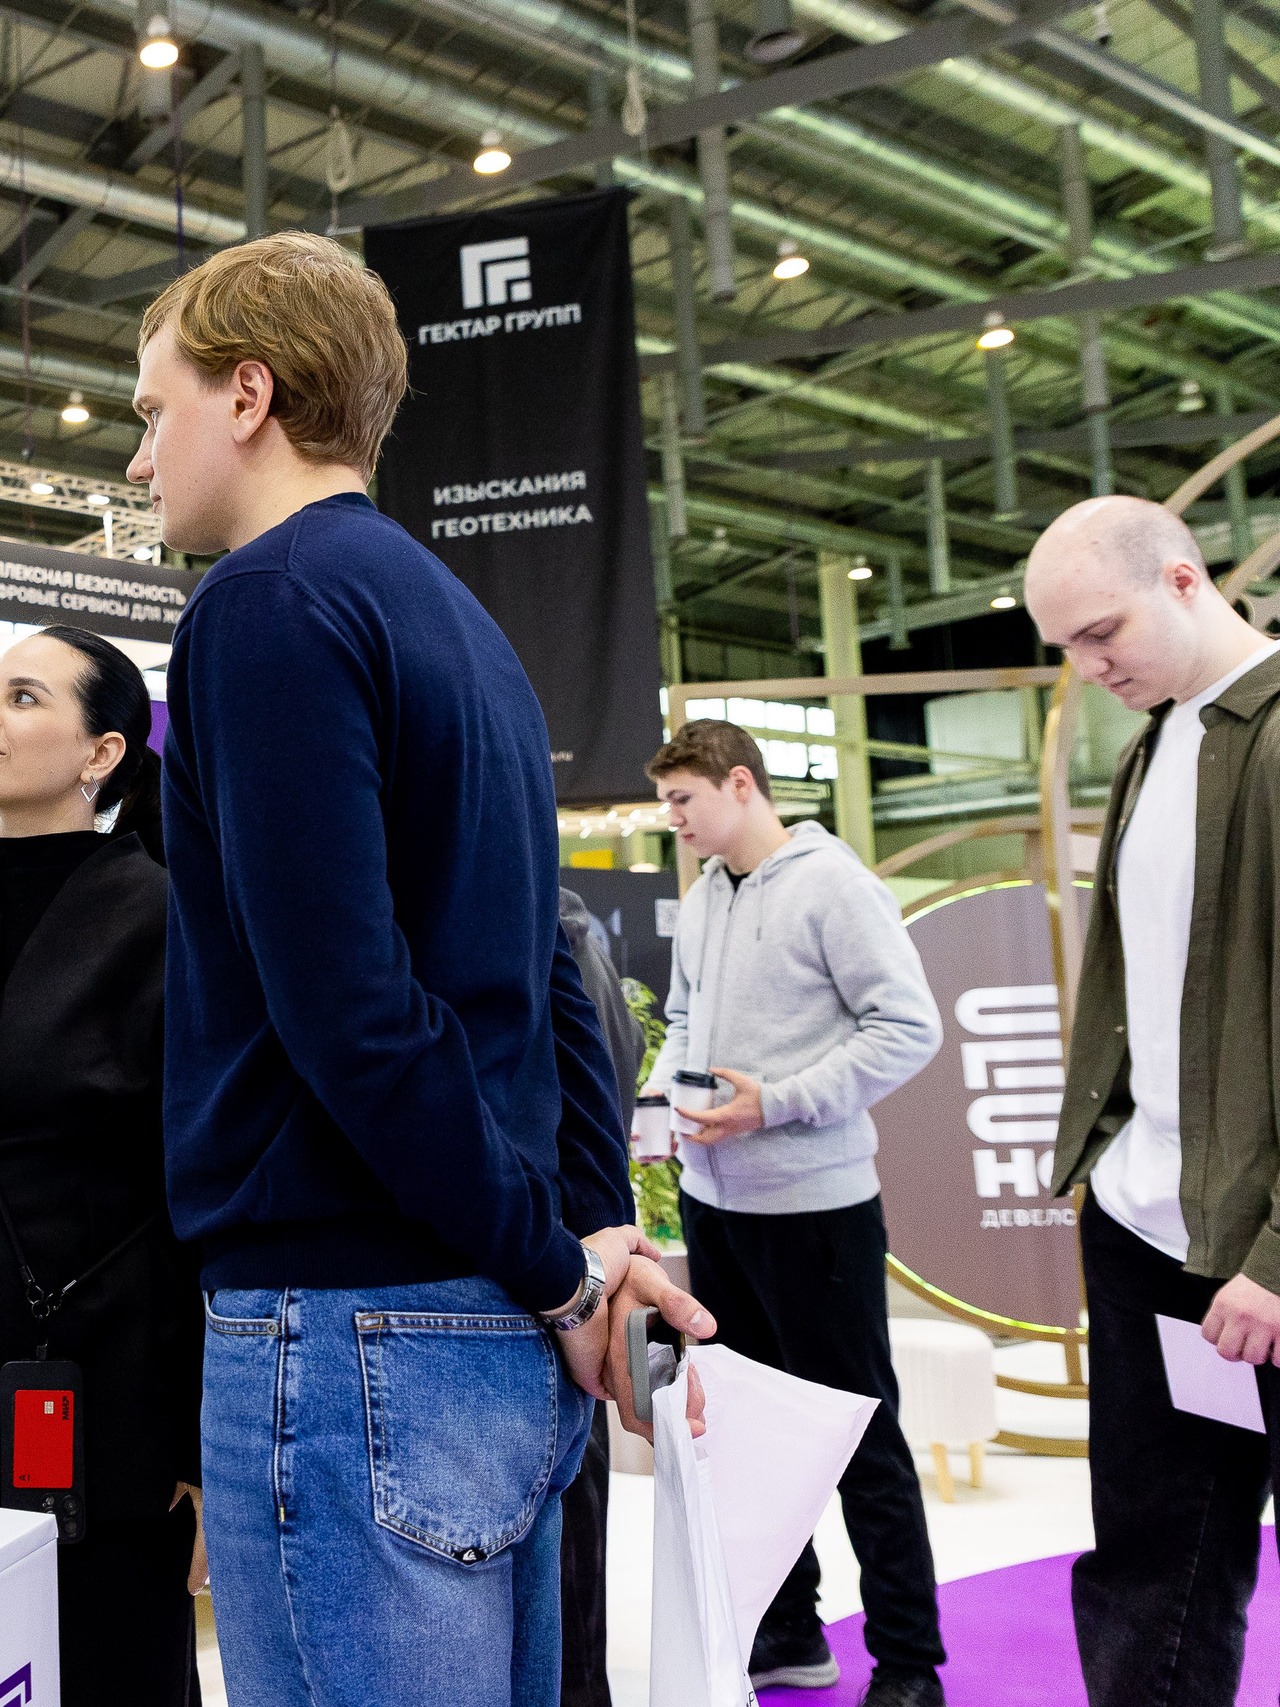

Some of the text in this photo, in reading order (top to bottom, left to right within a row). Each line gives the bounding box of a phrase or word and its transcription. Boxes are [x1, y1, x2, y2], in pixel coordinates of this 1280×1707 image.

[418, 302, 582, 346] ГЕКТАР ГРУПП
[433, 470, 587, 506] ИЗЫСКАНИЯ
[431, 504, 594, 539] ГЕОТЕХНИКА
[75, 573, 187, 606] БЕЗОПАСНОСТЬ
[61, 592, 130, 617] СЕРВИСЫ
[130, 602, 162, 622] ДЛЯ
[62, 1396, 70, 1420] МИР
